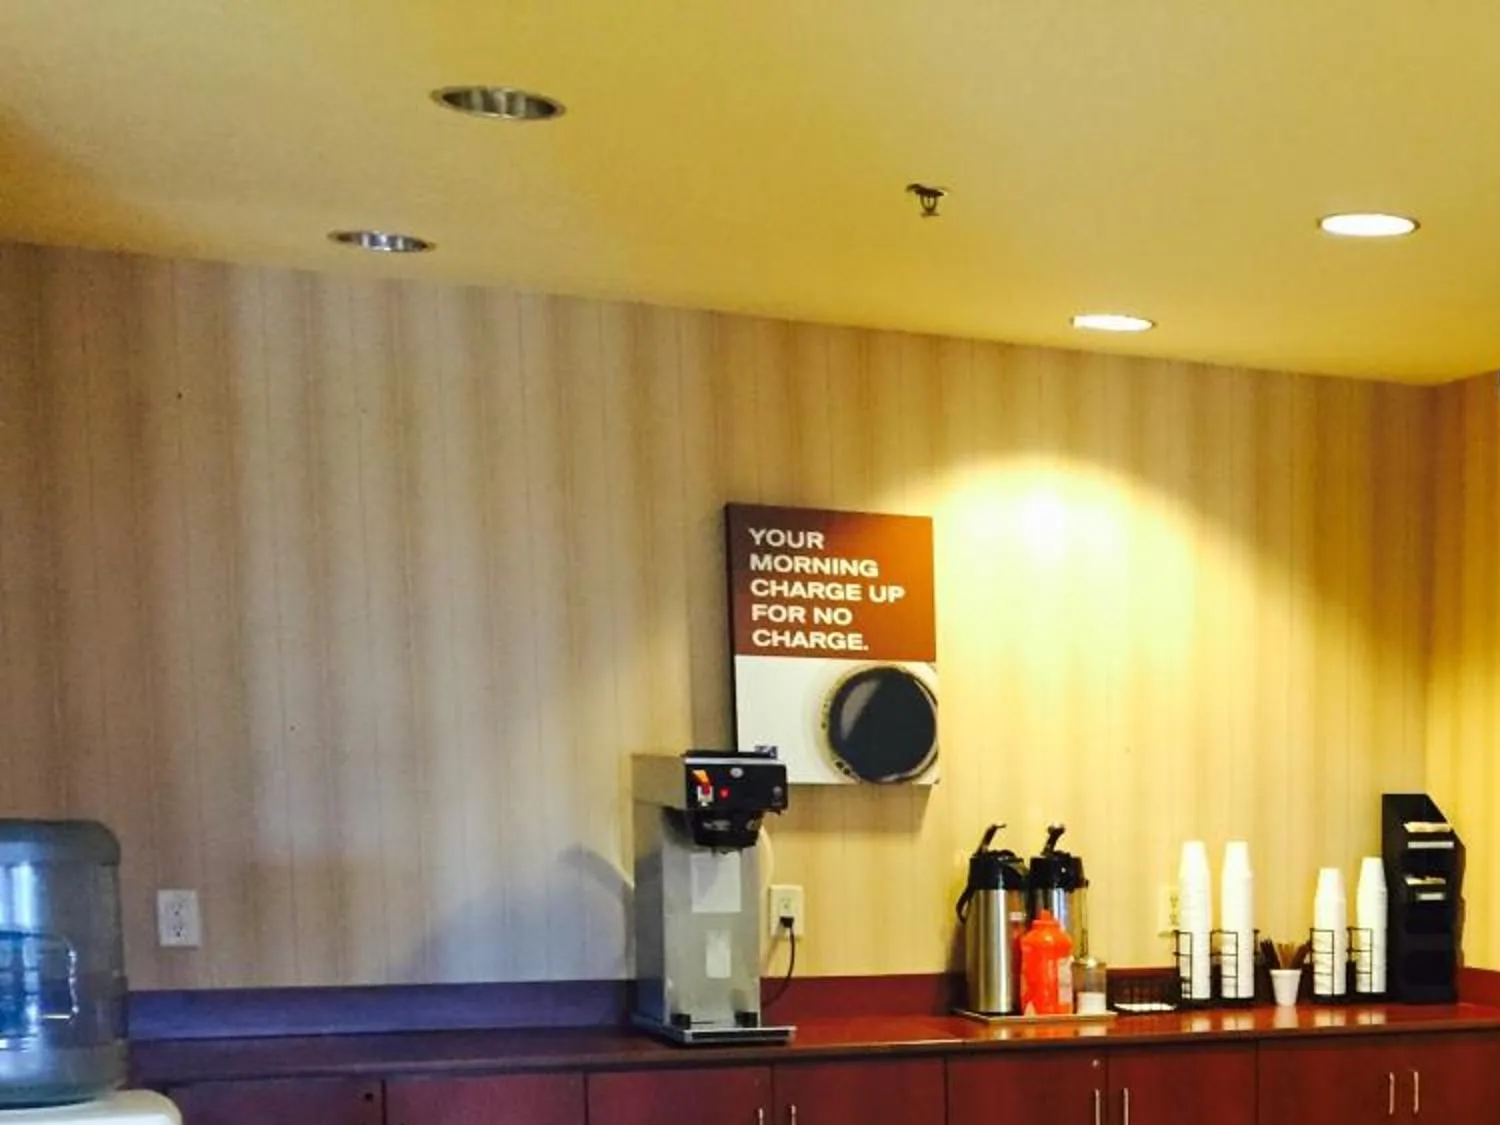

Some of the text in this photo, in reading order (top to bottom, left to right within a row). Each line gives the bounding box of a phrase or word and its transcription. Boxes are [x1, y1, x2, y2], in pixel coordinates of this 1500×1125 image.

[748, 528, 825, 550] YOUR
[749, 553, 879, 577] MORNING
[750, 579, 906, 603] CHARGE UP
[751, 603, 853, 626] FOR NO
[752, 629, 870, 651] CHARGE.
